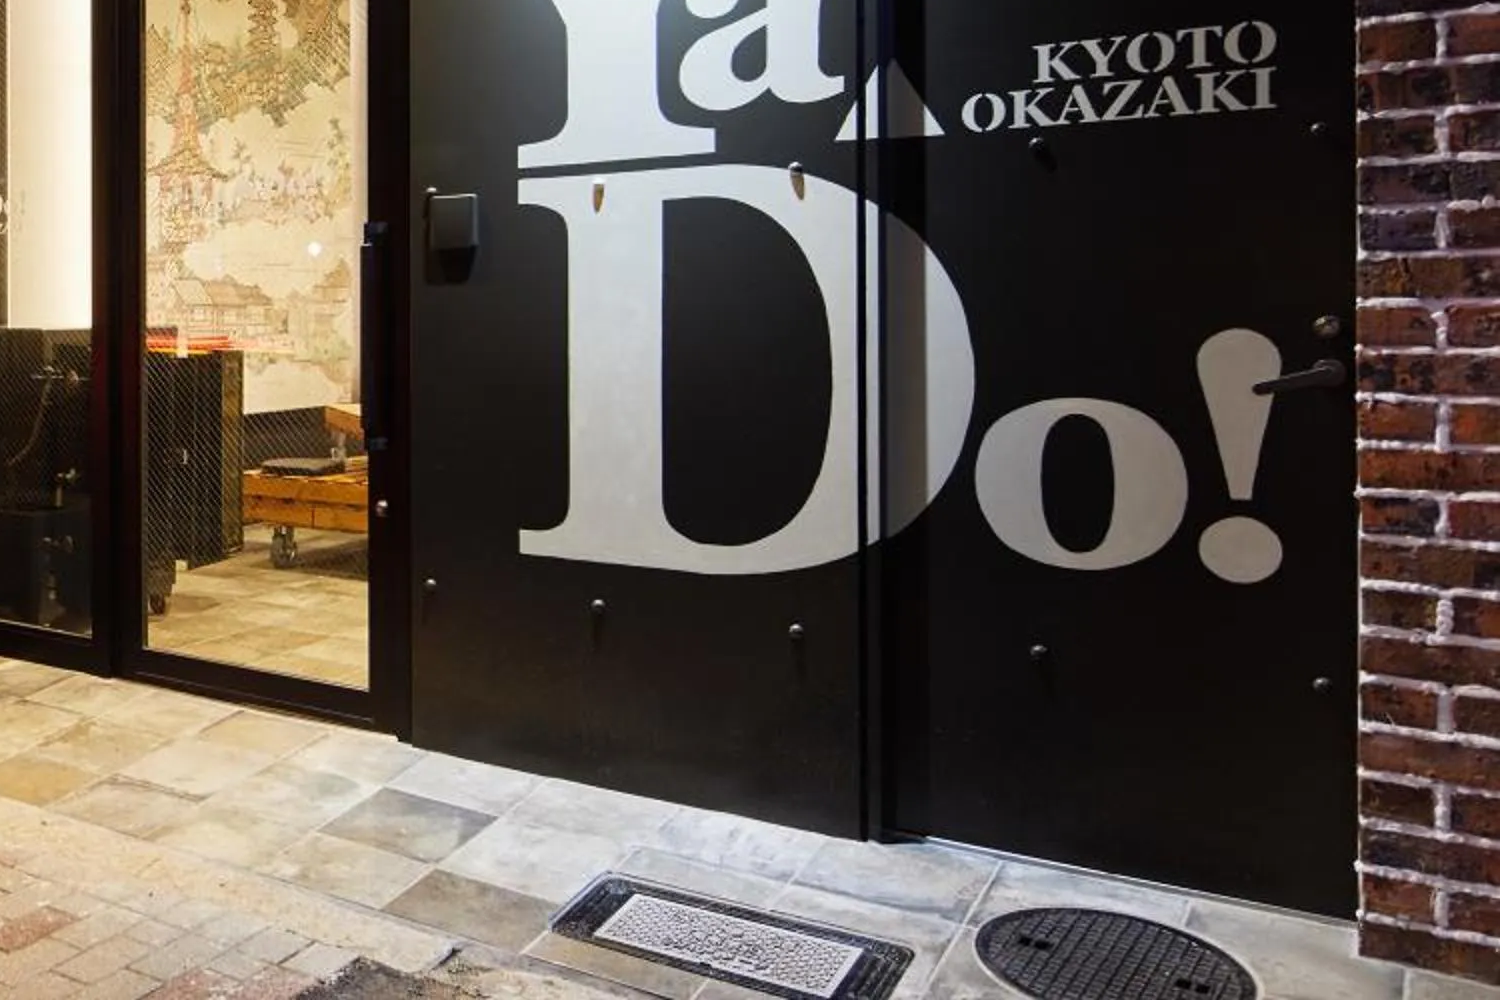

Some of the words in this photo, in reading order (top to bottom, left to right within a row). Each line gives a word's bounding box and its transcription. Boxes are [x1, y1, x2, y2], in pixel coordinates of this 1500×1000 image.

[1032, 21, 1277, 83] KYOTO
[961, 66, 1277, 133] OKAZAKI
[518, 164, 1284, 584] Do!
